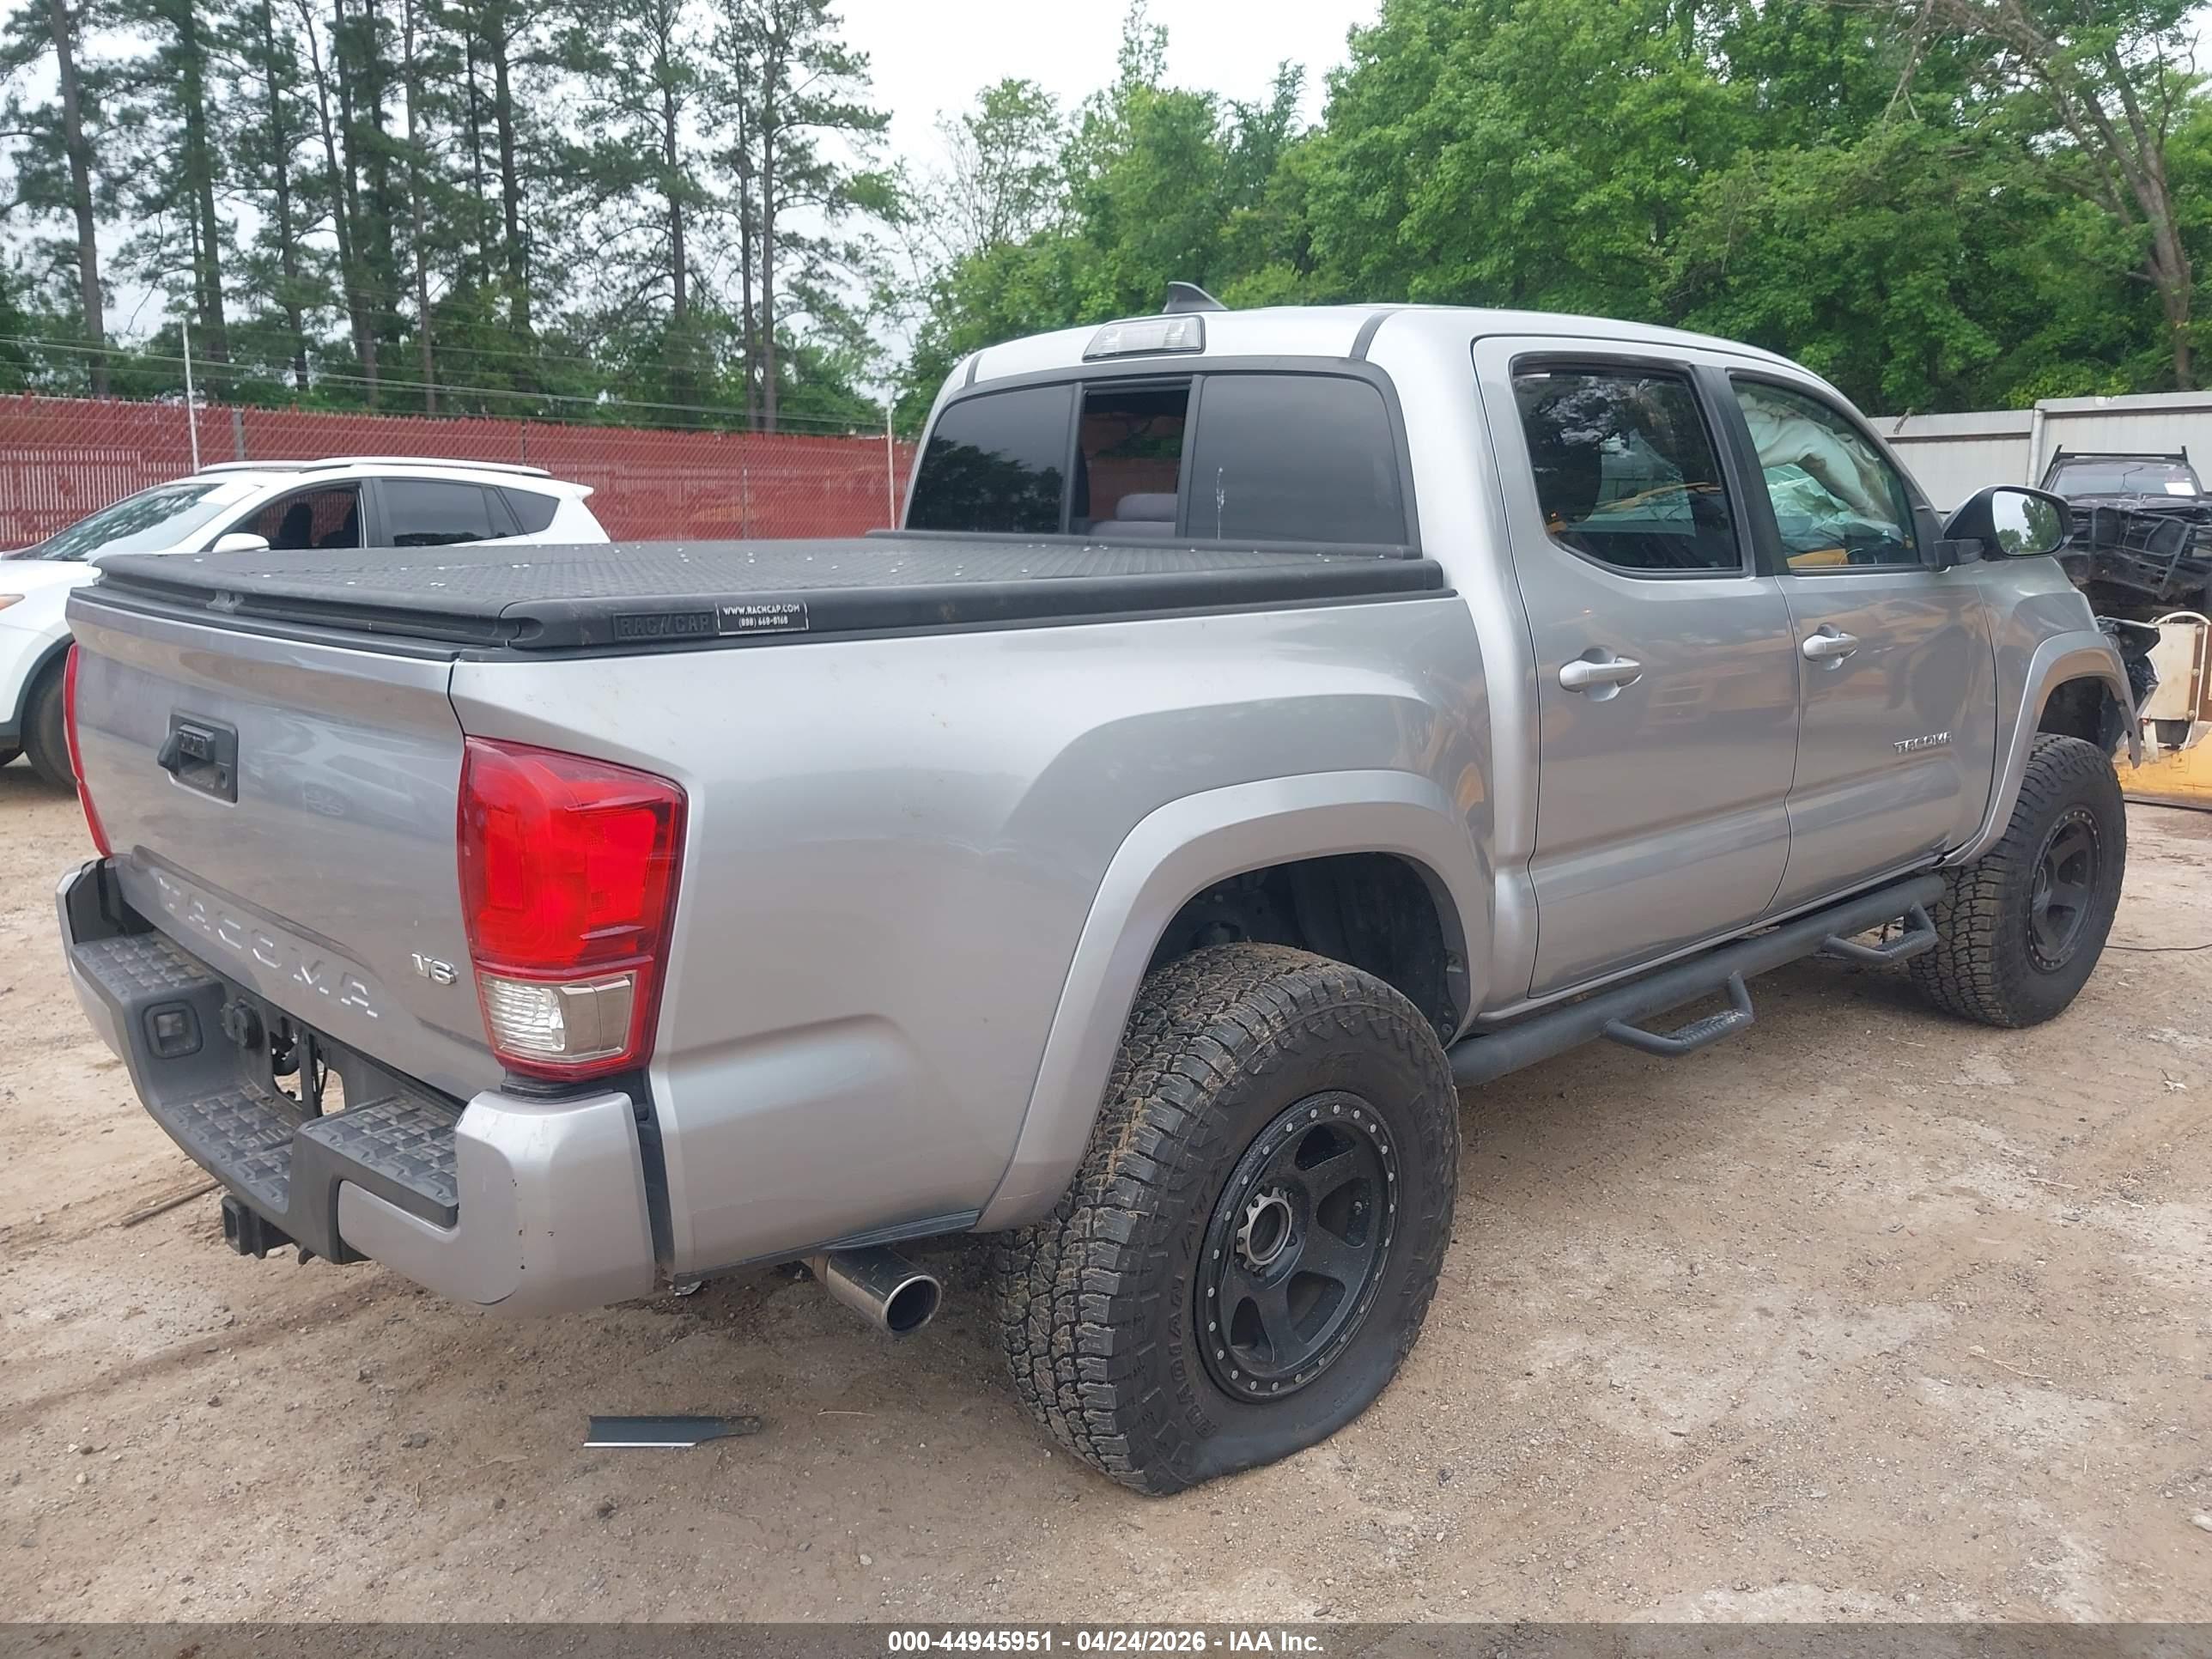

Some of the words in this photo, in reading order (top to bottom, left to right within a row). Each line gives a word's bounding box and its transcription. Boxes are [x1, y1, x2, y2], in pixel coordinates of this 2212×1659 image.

[1892, 730, 1952, 754] TACOMA
[158, 876, 379, 1018] TACOMA
[411, 952, 459, 986] V6
